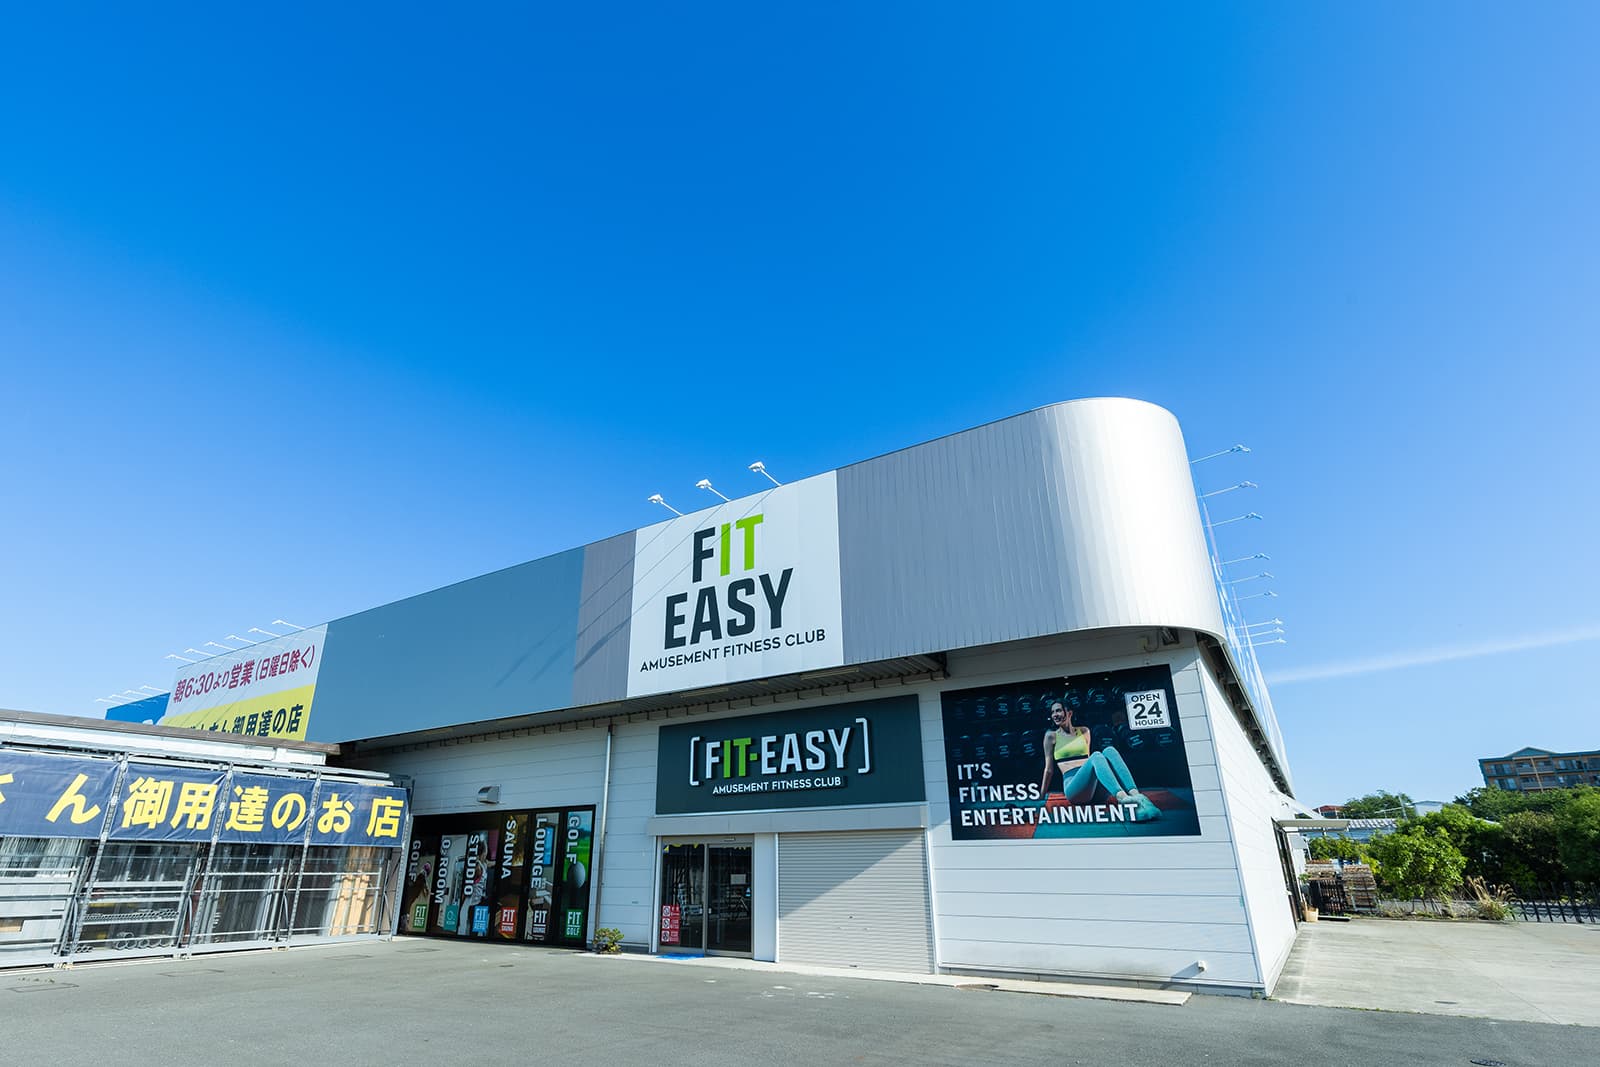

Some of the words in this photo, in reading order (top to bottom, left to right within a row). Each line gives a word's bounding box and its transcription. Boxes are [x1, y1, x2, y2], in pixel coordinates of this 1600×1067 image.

[693, 513, 764, 583] FIT
[664, 567, 793, 650] EASY
[640, 647, 719, 672] AMUSEMENT
[723, 636, 781, 658] FITNESS
[785, 628, 826, 647] CLUB
[1131, 693, 1160, 702] OPEN
[1132, 701, 1163, 720] 24
[1135, 718, 1165, 726] HOURS
[957, 762, 993, 781] IT'S
[713, 781, 769, 794] AMUSEMENT
[772, 779, 812, 790] FITNESS
[814, 776, 842, 787] CLUB
[959, 783, 1041, 803] FITNESS
[961, 803, 1138, 827] ENTERTAINMENT
[501, 819, 517, 879] SAUNA
[566, 815, 580, 865] GOLF
[409, 840, 421, 883] GOLF
[531, 817, 547, 889] LOUNGE
[464, 834, 479, 896] STUDIO
[415, 905, 426, 917] FIT
[475, 908, 488, 921] FIT
[502, 909, 515, 922] FIT
[534, 910, 547, 924] FIT
[567, 911, 581, 925] FIT
[566, 927, 580, 936] GOLF
